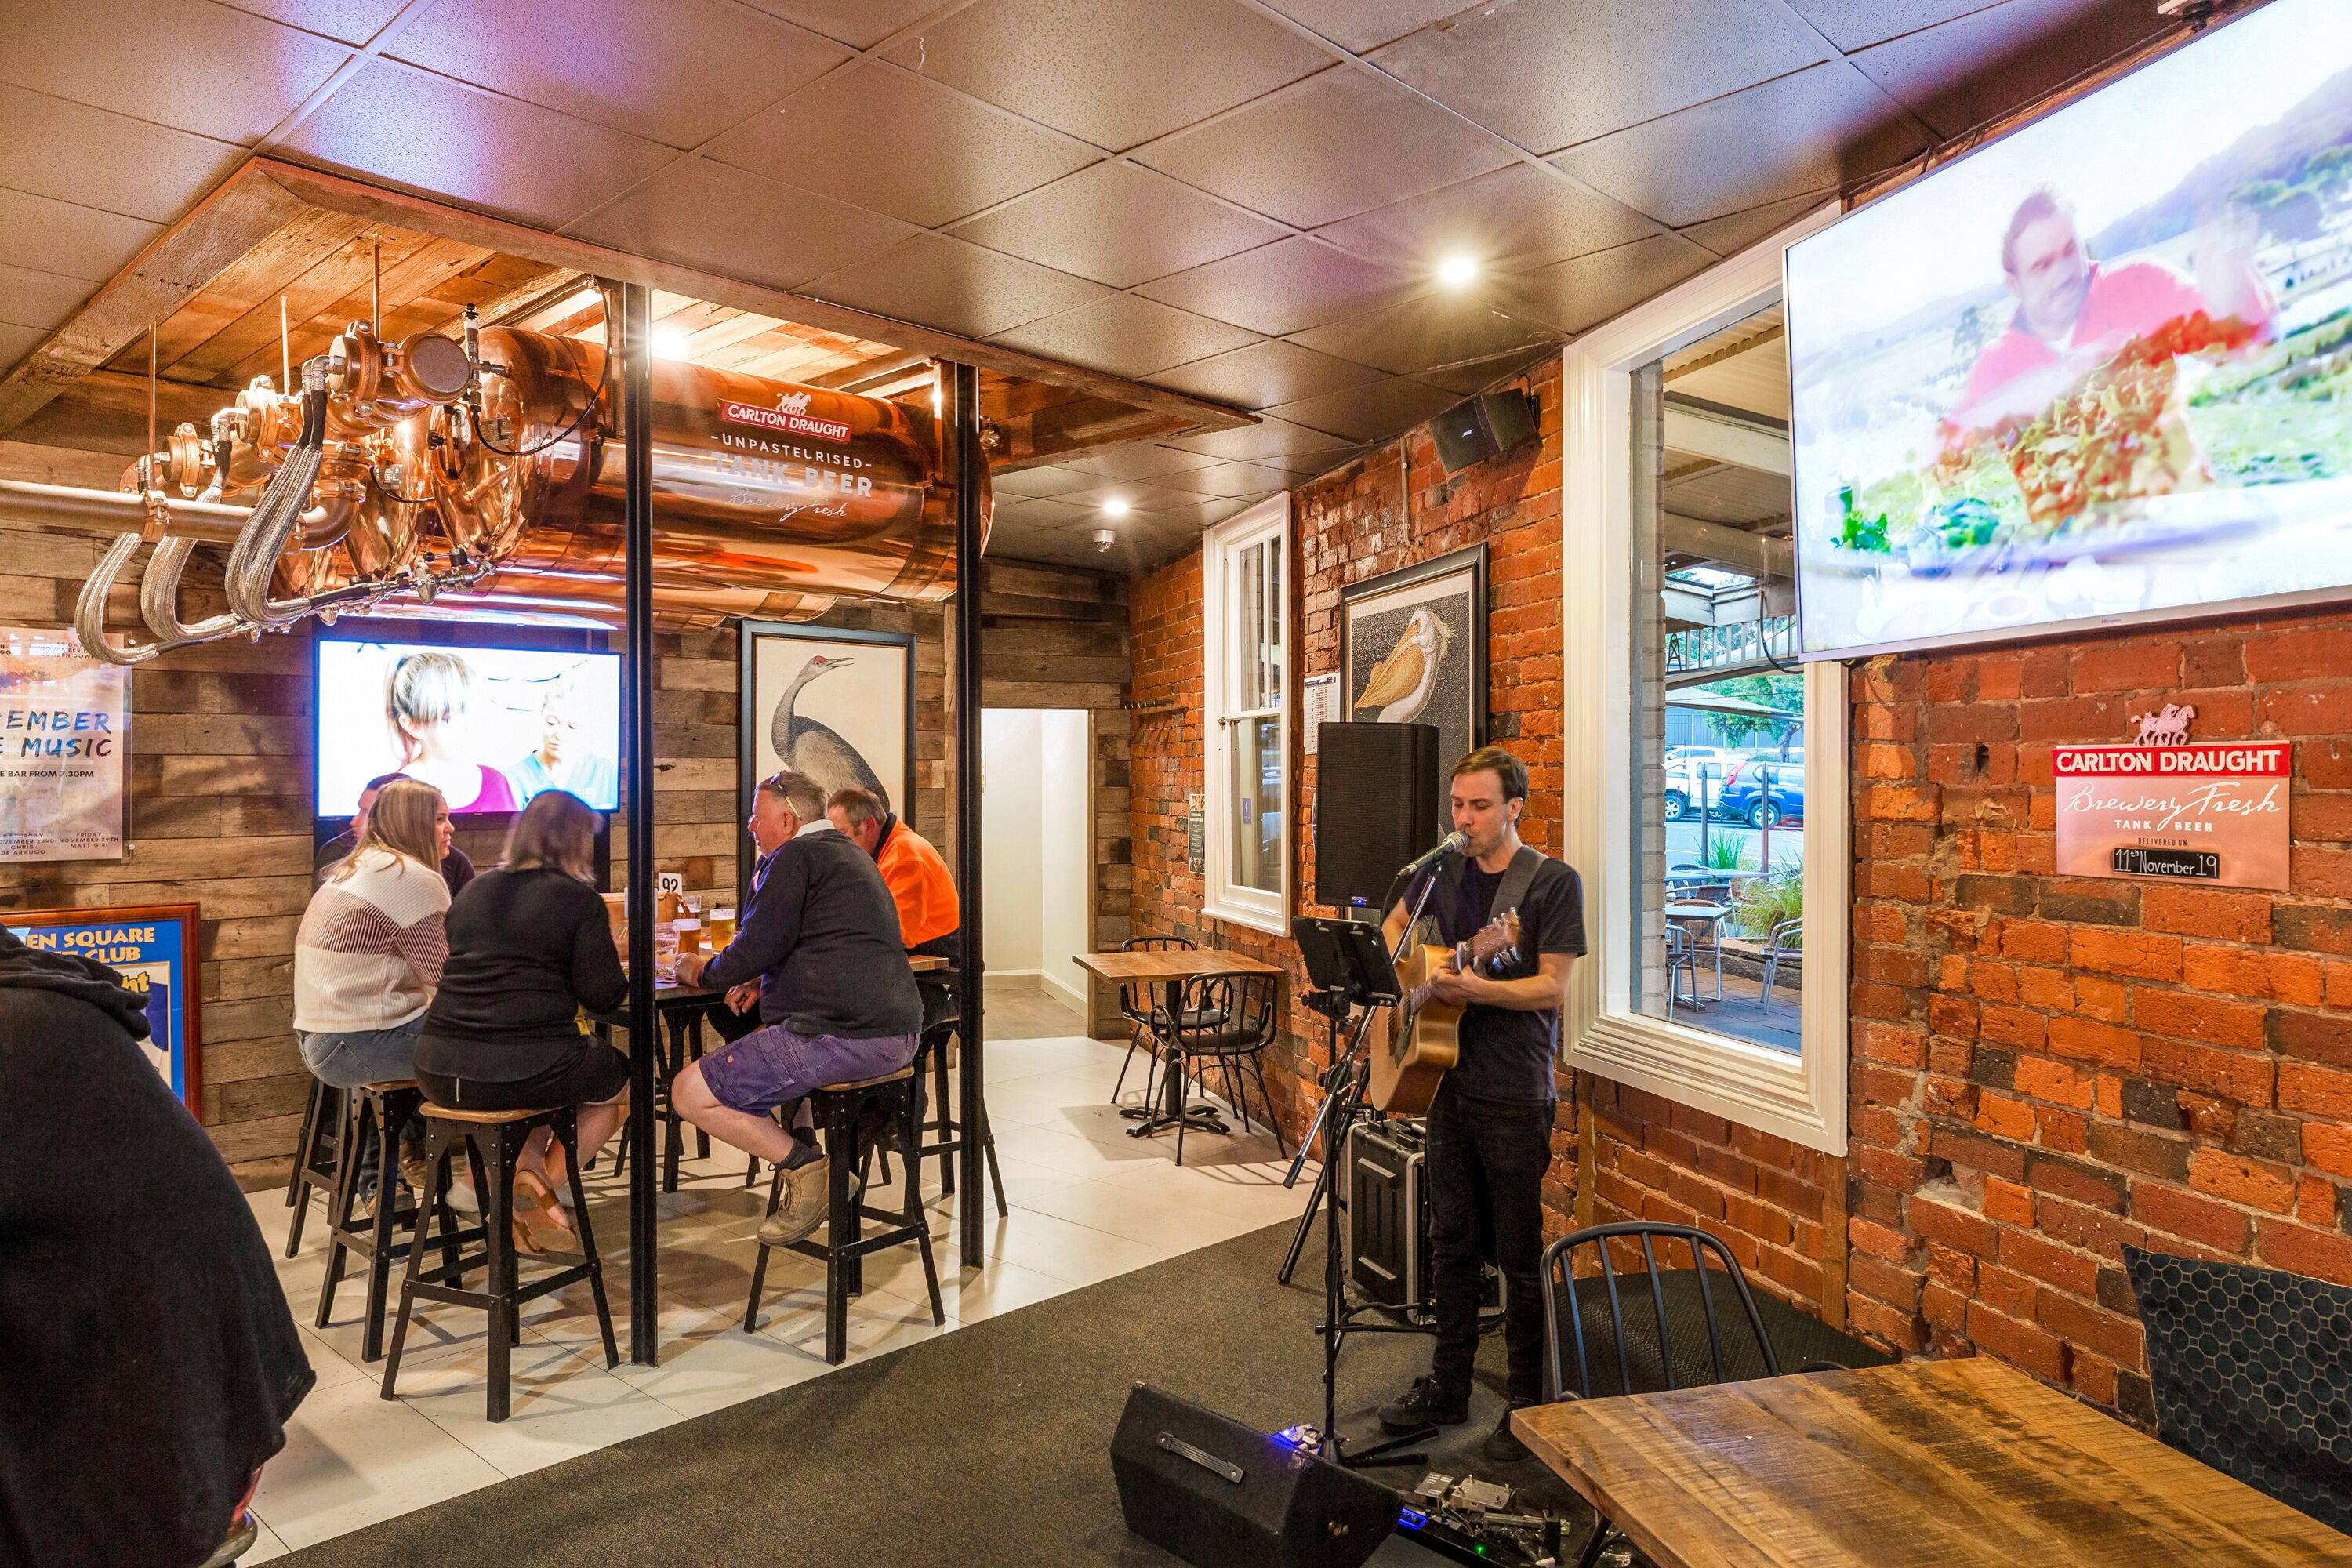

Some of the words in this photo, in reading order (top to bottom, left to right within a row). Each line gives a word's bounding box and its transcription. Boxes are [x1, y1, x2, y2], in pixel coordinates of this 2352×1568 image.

[728, 405, 786, 427] CARLTON
[789, 416, 849, 438] DRAUGHT
[710, 451, 791, 485] TANK
[804, 466, 873, 498] BEER
[724, 486, 801, 522] Brewery
[0, 710, 111, 735] EMBER
[20, 737, 112, 758] MUSIC
[2056, 751, 2153, 773] CARLTON
[2159, 750, 2281, 772] DRAUGHT
[2062, 781, 2183, 832] Brewery
[2186, 781, 2282, 815] Fresh
[2114, 819, 2152, 830] TANK
[2174, 821, 2213, 833] BEER
[2138, 837, 2176, 847] DELIVERED
[2114, 848, 2140, 872] 11th
[2139, 851, 2195, 875] November
[662, 877, 678, 893] 92
[24, 933, 56, 949] EN
[64, 927, 155, 948] SQUARE
[84, 946, 141, 964] CLUB
